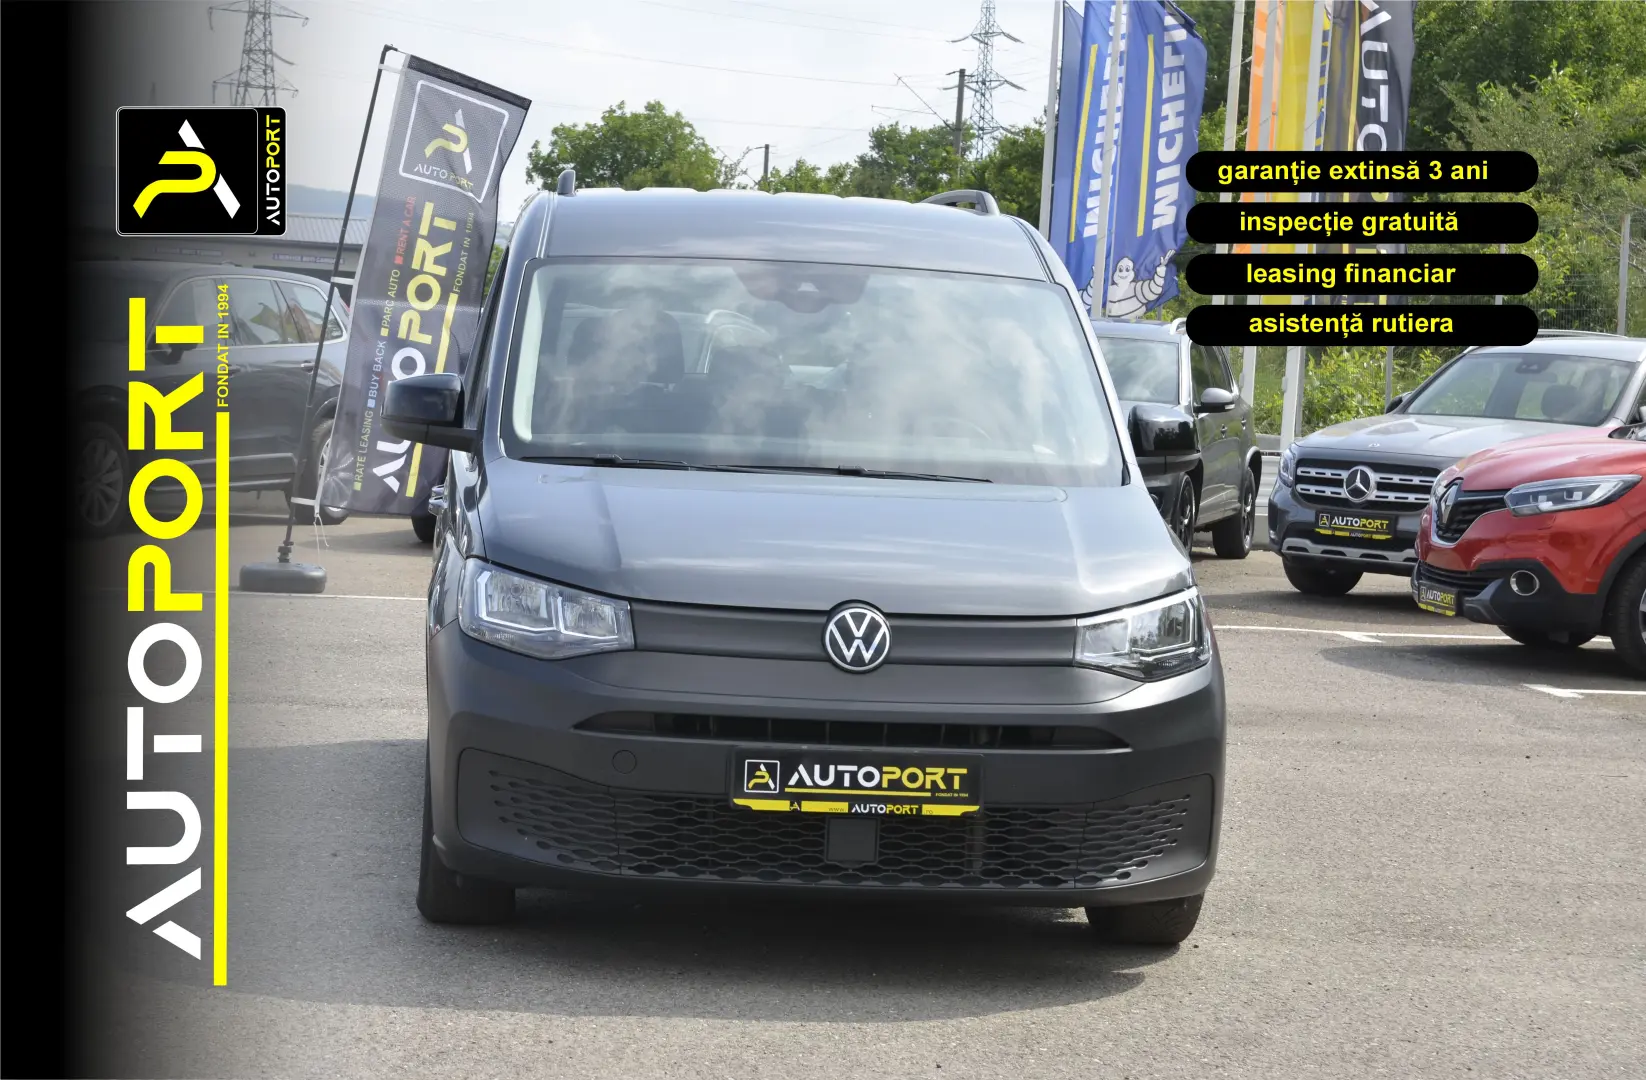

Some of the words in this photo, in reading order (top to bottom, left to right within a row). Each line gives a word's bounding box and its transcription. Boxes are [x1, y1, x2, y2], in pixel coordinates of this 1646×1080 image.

[403, 196, 416, 216] CAR
[403, 217, 412, 227] A
[465, 212, 474, 233] 1994
[396, 228, 409, 256] RENT
[463, 237, 471, 248] IN
[387, 269, 401, 298] AUTO
[453, 252, 468, 293] FONDAT
[381, 300, 395, 328] PARC
[373, 340, 387, 372] BACK
[368, 379, 380, 398] BUY
[359, 410, 374, 454] LEASING
[354, 457, 367, 483] RATE
[1331, 516, 1389, 529] AUTOPORT
[1426, 590, 1455, 605] AUTOPORT
[788, 763, 968, 790] AUTOPORT
[851, 803, 919, 815] AUTOPORT
